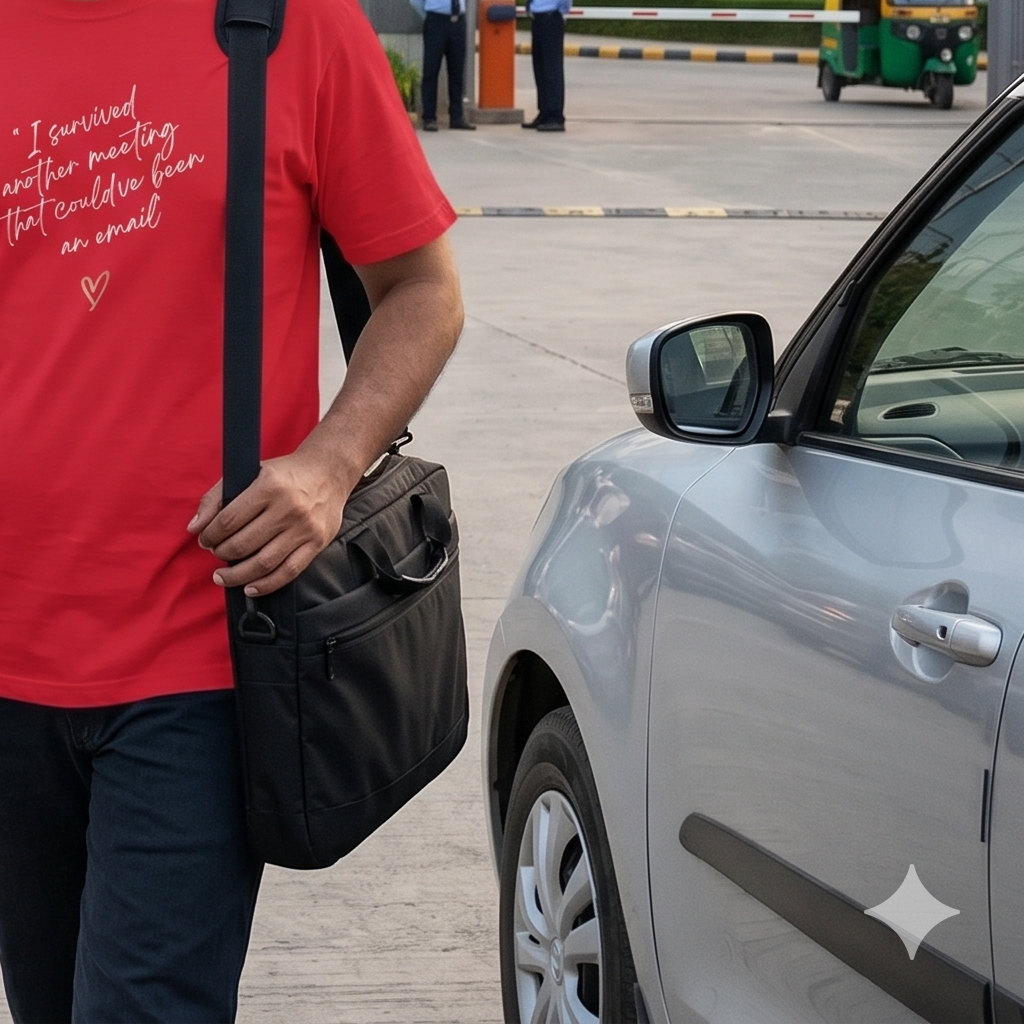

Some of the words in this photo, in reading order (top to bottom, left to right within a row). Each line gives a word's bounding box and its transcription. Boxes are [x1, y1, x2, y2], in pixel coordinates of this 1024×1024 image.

[48, 83, 137, 147] survived
[2, 156, 80, 197] another
[88, 120, 180, 171] meeting
[151, 152, 205, 189] been
[60, 236, 90, 256] an
